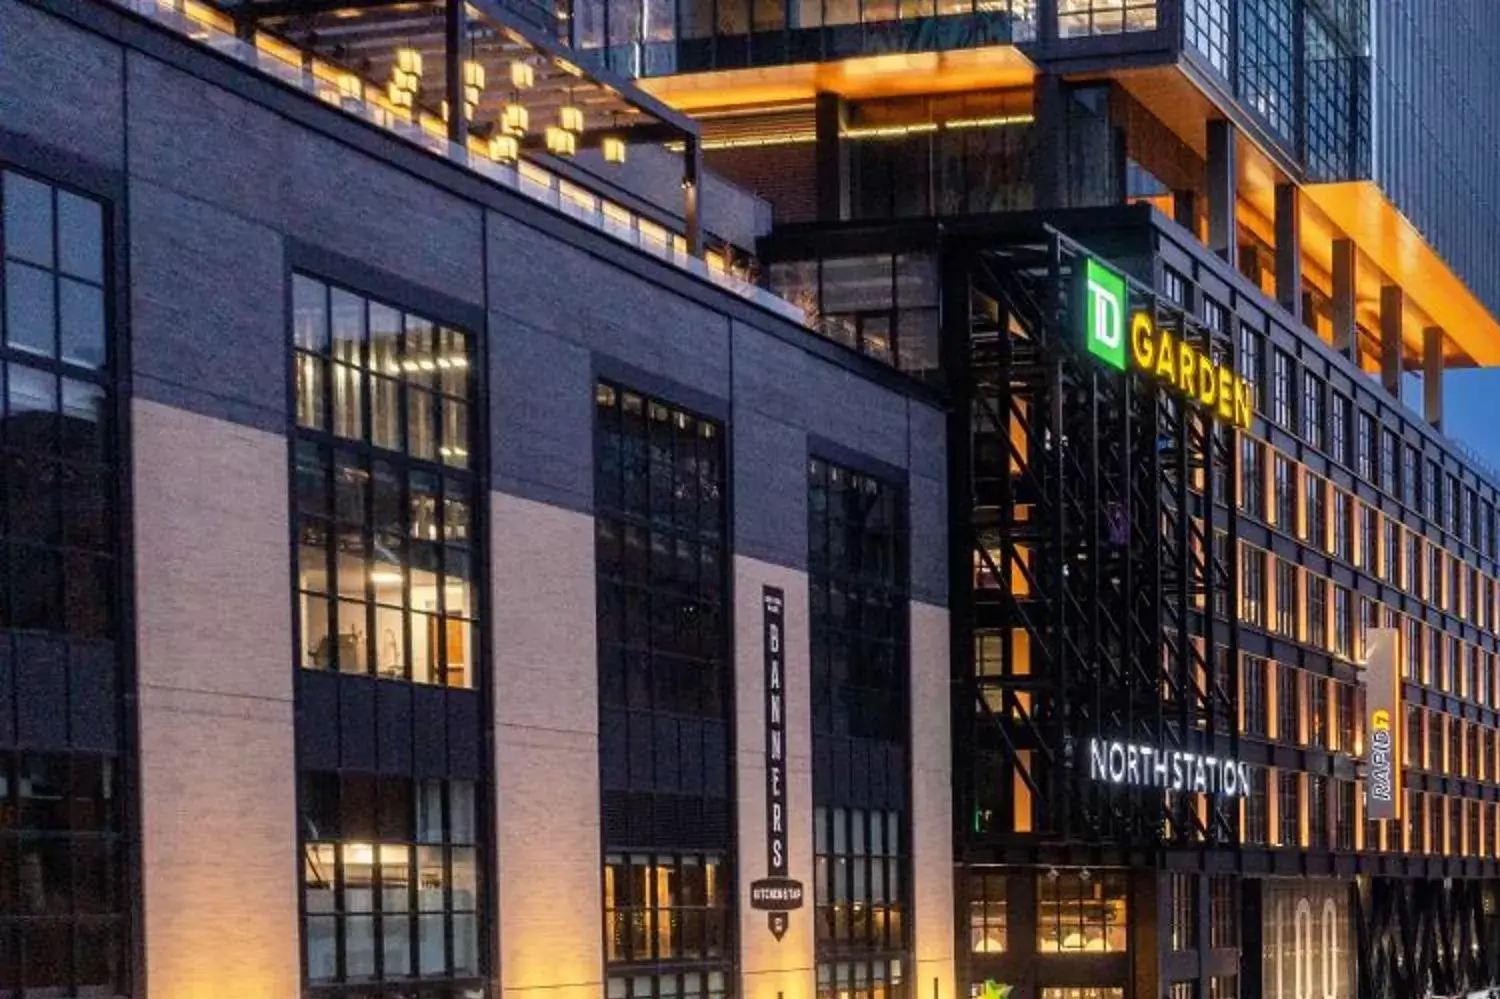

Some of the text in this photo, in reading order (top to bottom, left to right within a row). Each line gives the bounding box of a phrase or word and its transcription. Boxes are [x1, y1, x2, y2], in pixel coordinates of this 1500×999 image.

[1088, 280, 1252, 430] TD GARDEN
[769, 623, 782, 868] BANNERS
[1090, 737, 1250, 797] NORTH STATION
